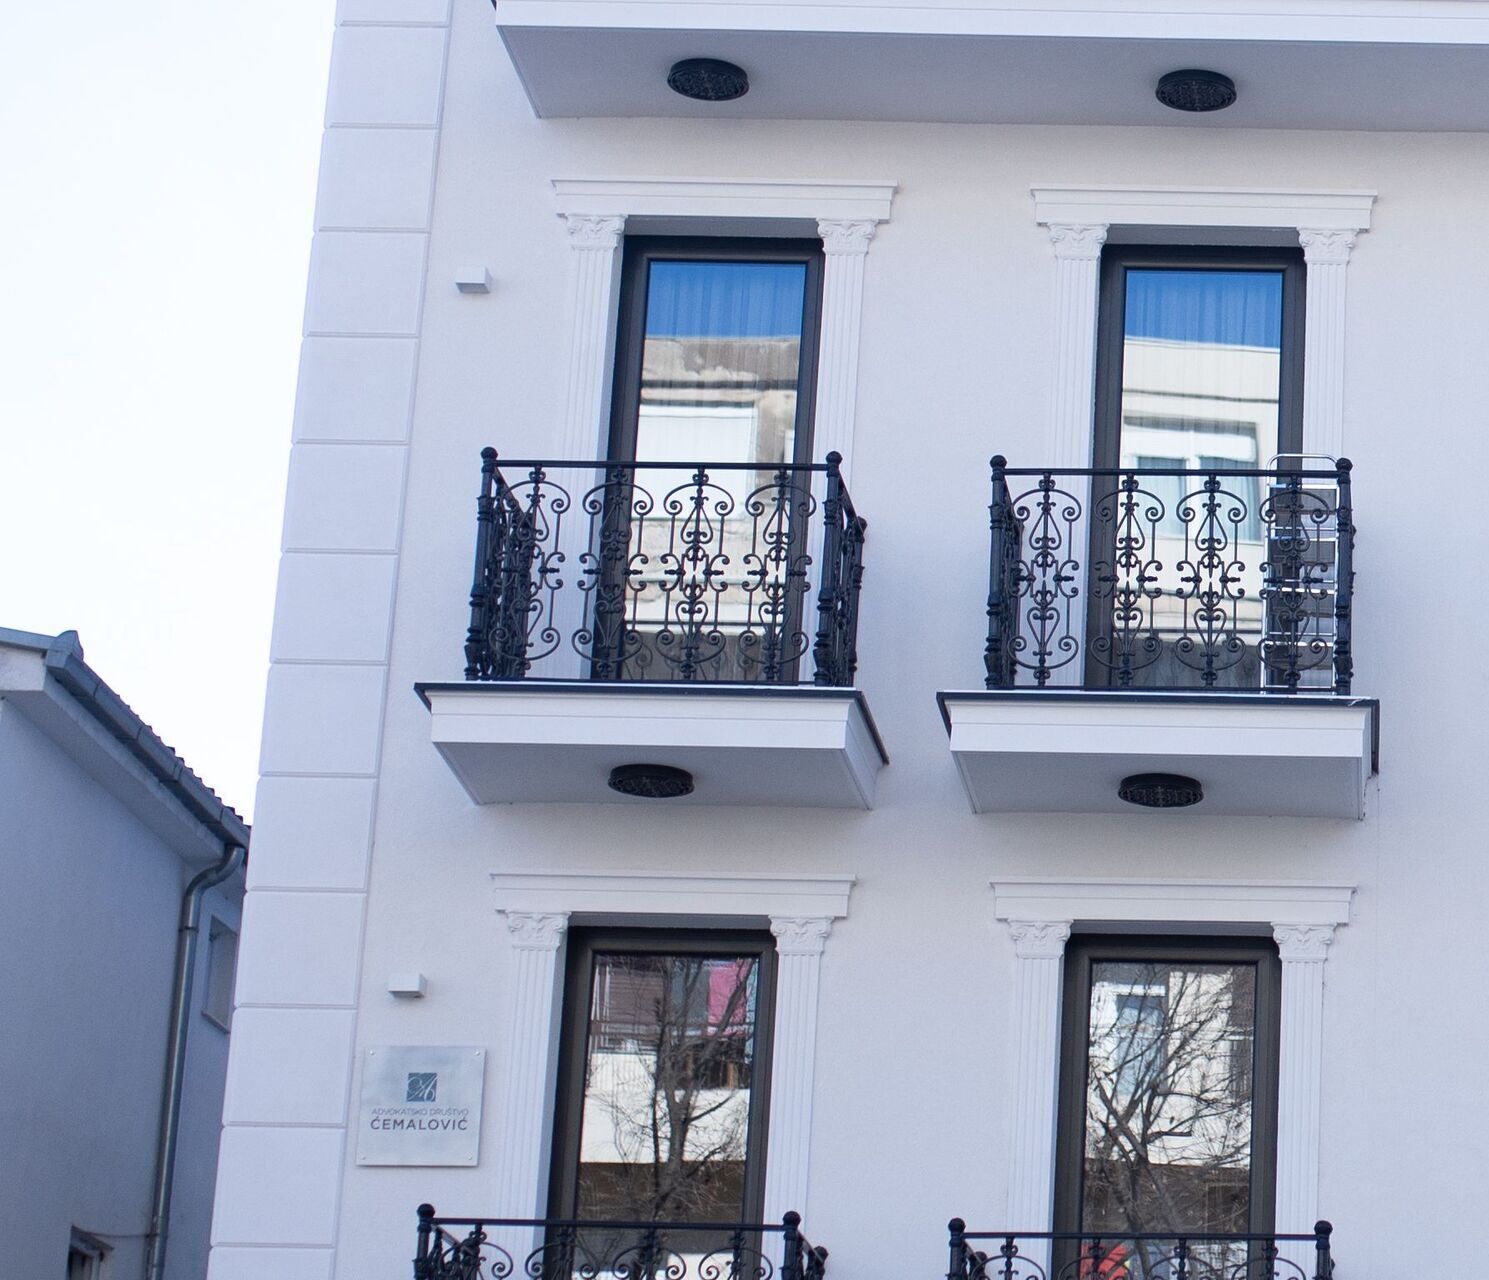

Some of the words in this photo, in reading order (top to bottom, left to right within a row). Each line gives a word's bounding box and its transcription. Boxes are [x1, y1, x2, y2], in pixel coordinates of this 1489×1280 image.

[371, 1108, 428, 1116] ADVOKATSKO
[429, 1107, 469, 1116] DRUŠTVO
[370, 1116, 468, 1131] ĆEMALOVIĆ
